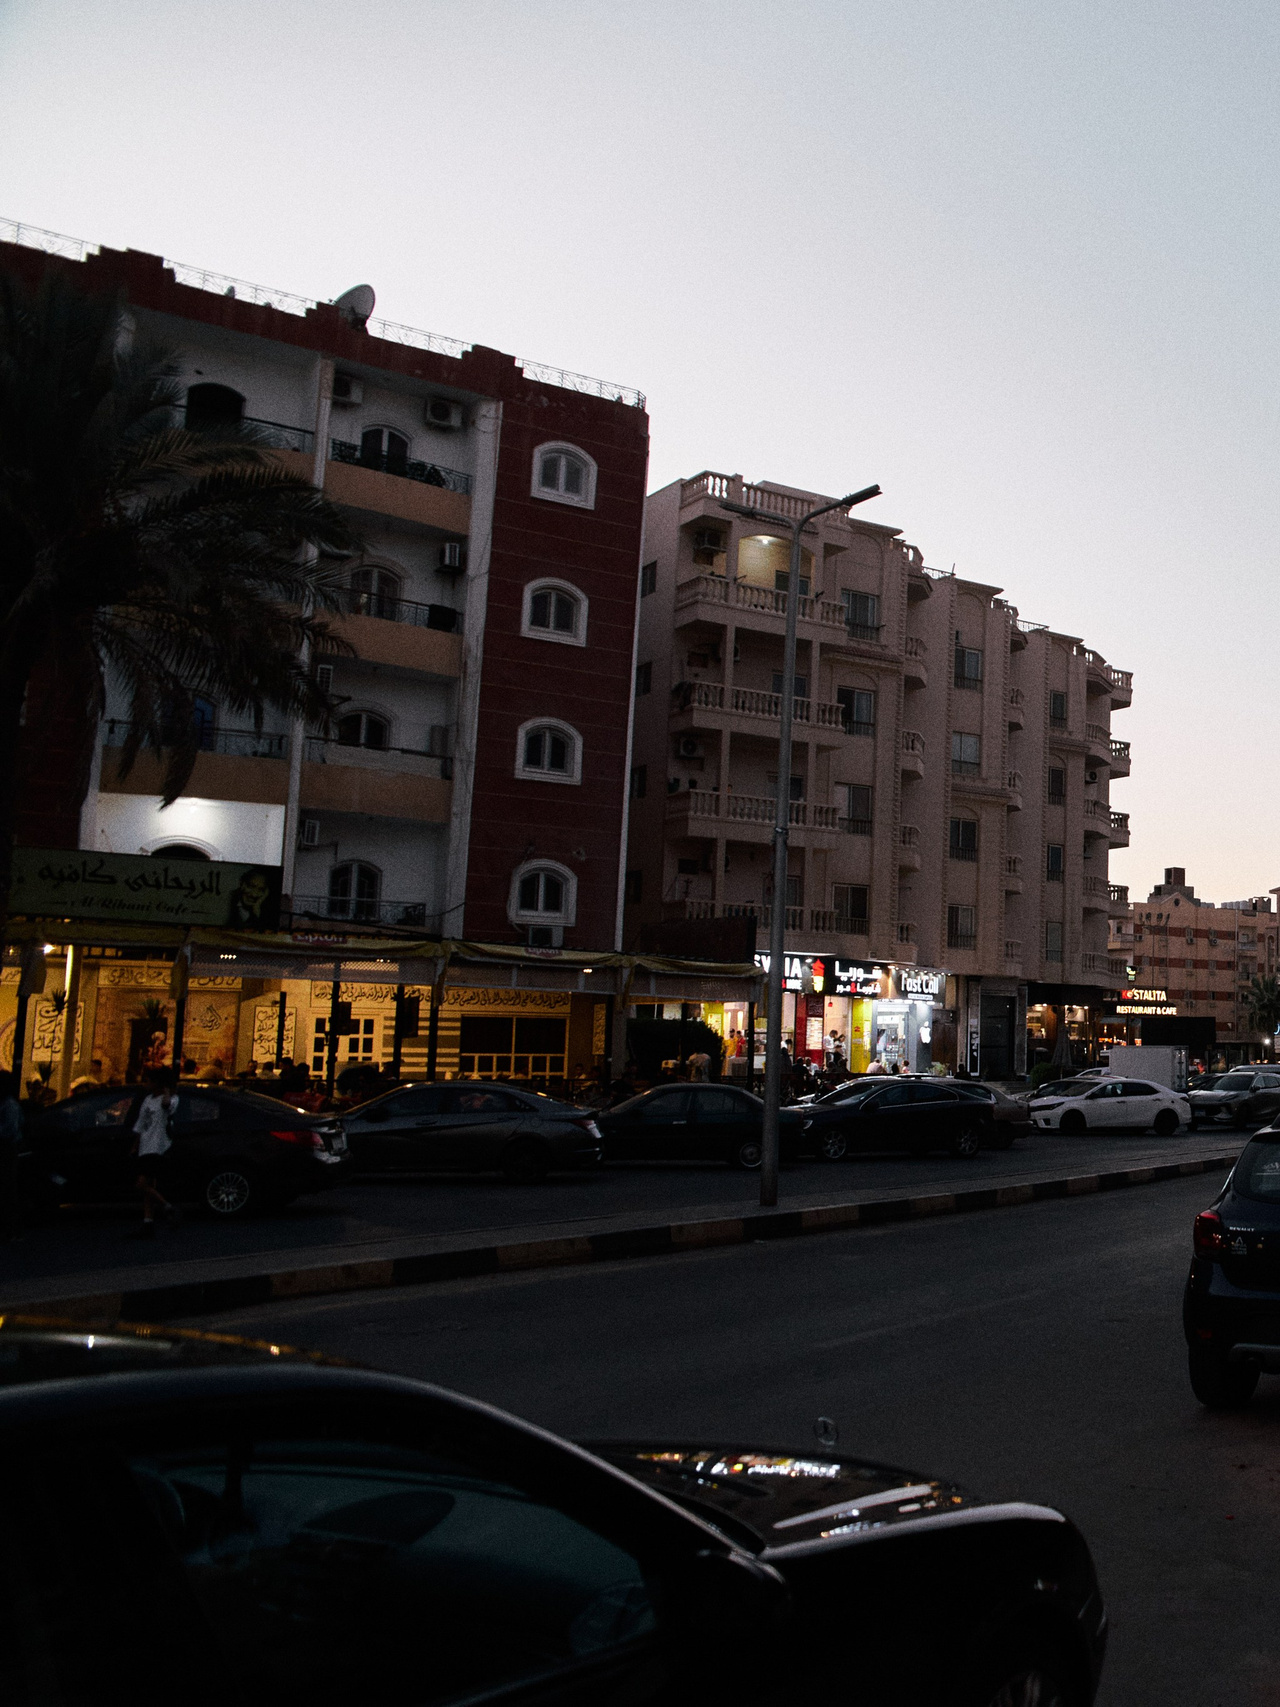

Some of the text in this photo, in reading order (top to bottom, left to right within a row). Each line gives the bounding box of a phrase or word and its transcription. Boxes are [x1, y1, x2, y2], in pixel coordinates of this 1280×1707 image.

[38, 858, 117, 889] كافيه
[753, 953, 803, 978] SYIA
[834, 960, 882, 982] سوريا
[901, 972, 939, 994] Fast Call
[1116, 1005, 1156, 1015] RESTAURANT
